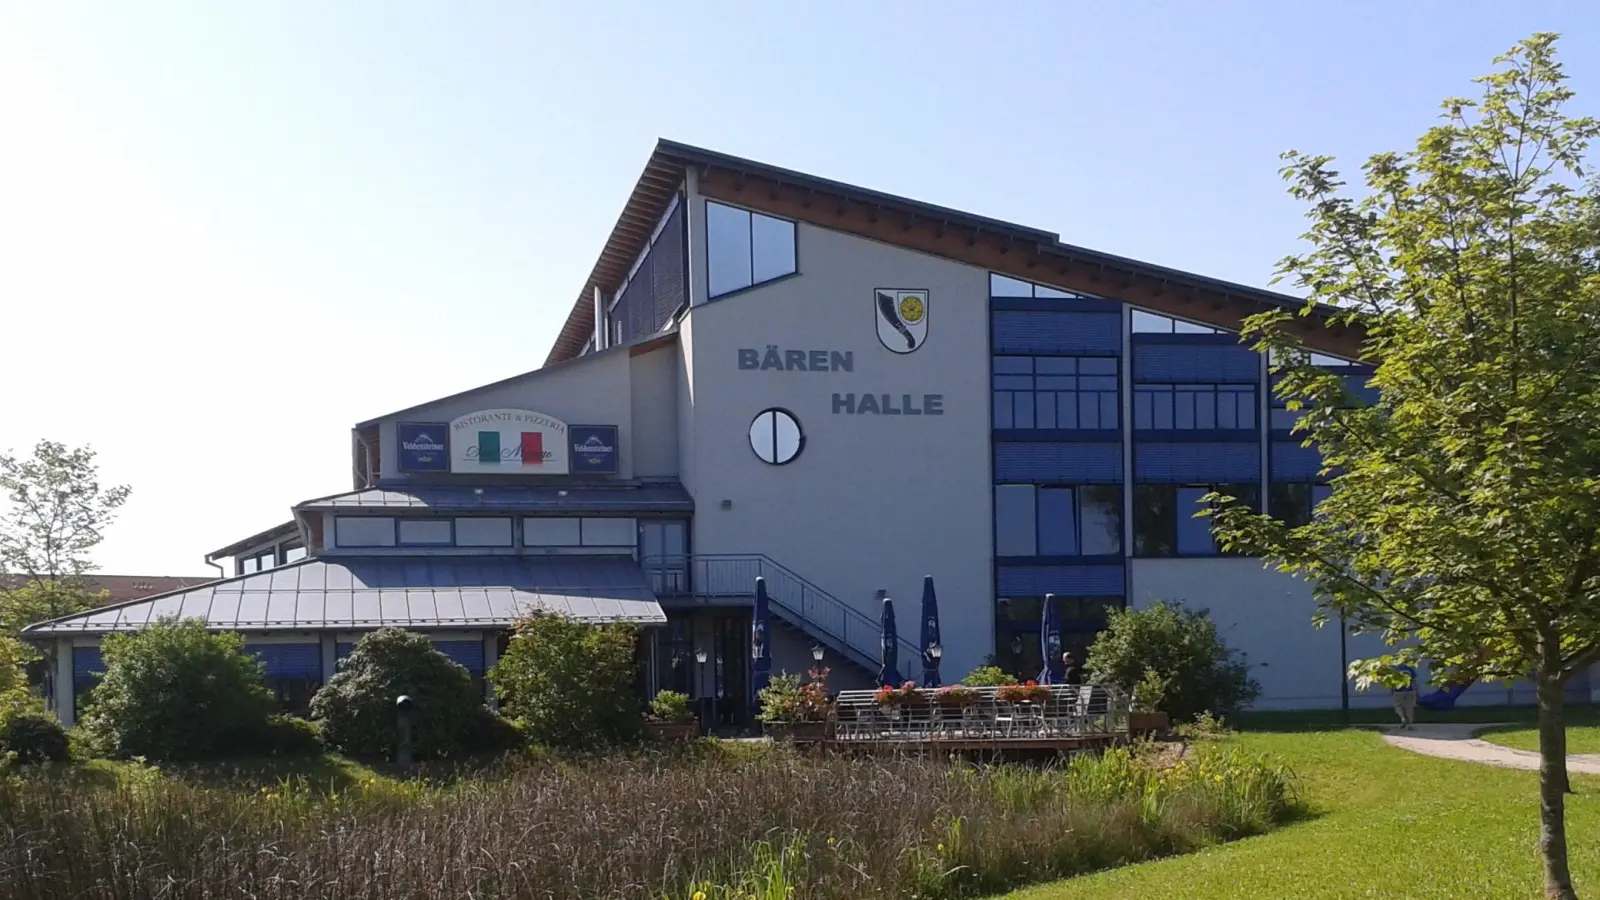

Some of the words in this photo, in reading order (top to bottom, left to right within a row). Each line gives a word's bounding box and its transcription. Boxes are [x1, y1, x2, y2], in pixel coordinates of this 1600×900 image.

[738, 345, 853, 372] BÄREN
[832, 393, 944, 415] HALLE
[453, 412, 512, 431] RISTORANTE
[525, 413, 565, 434] PIZZERIA
